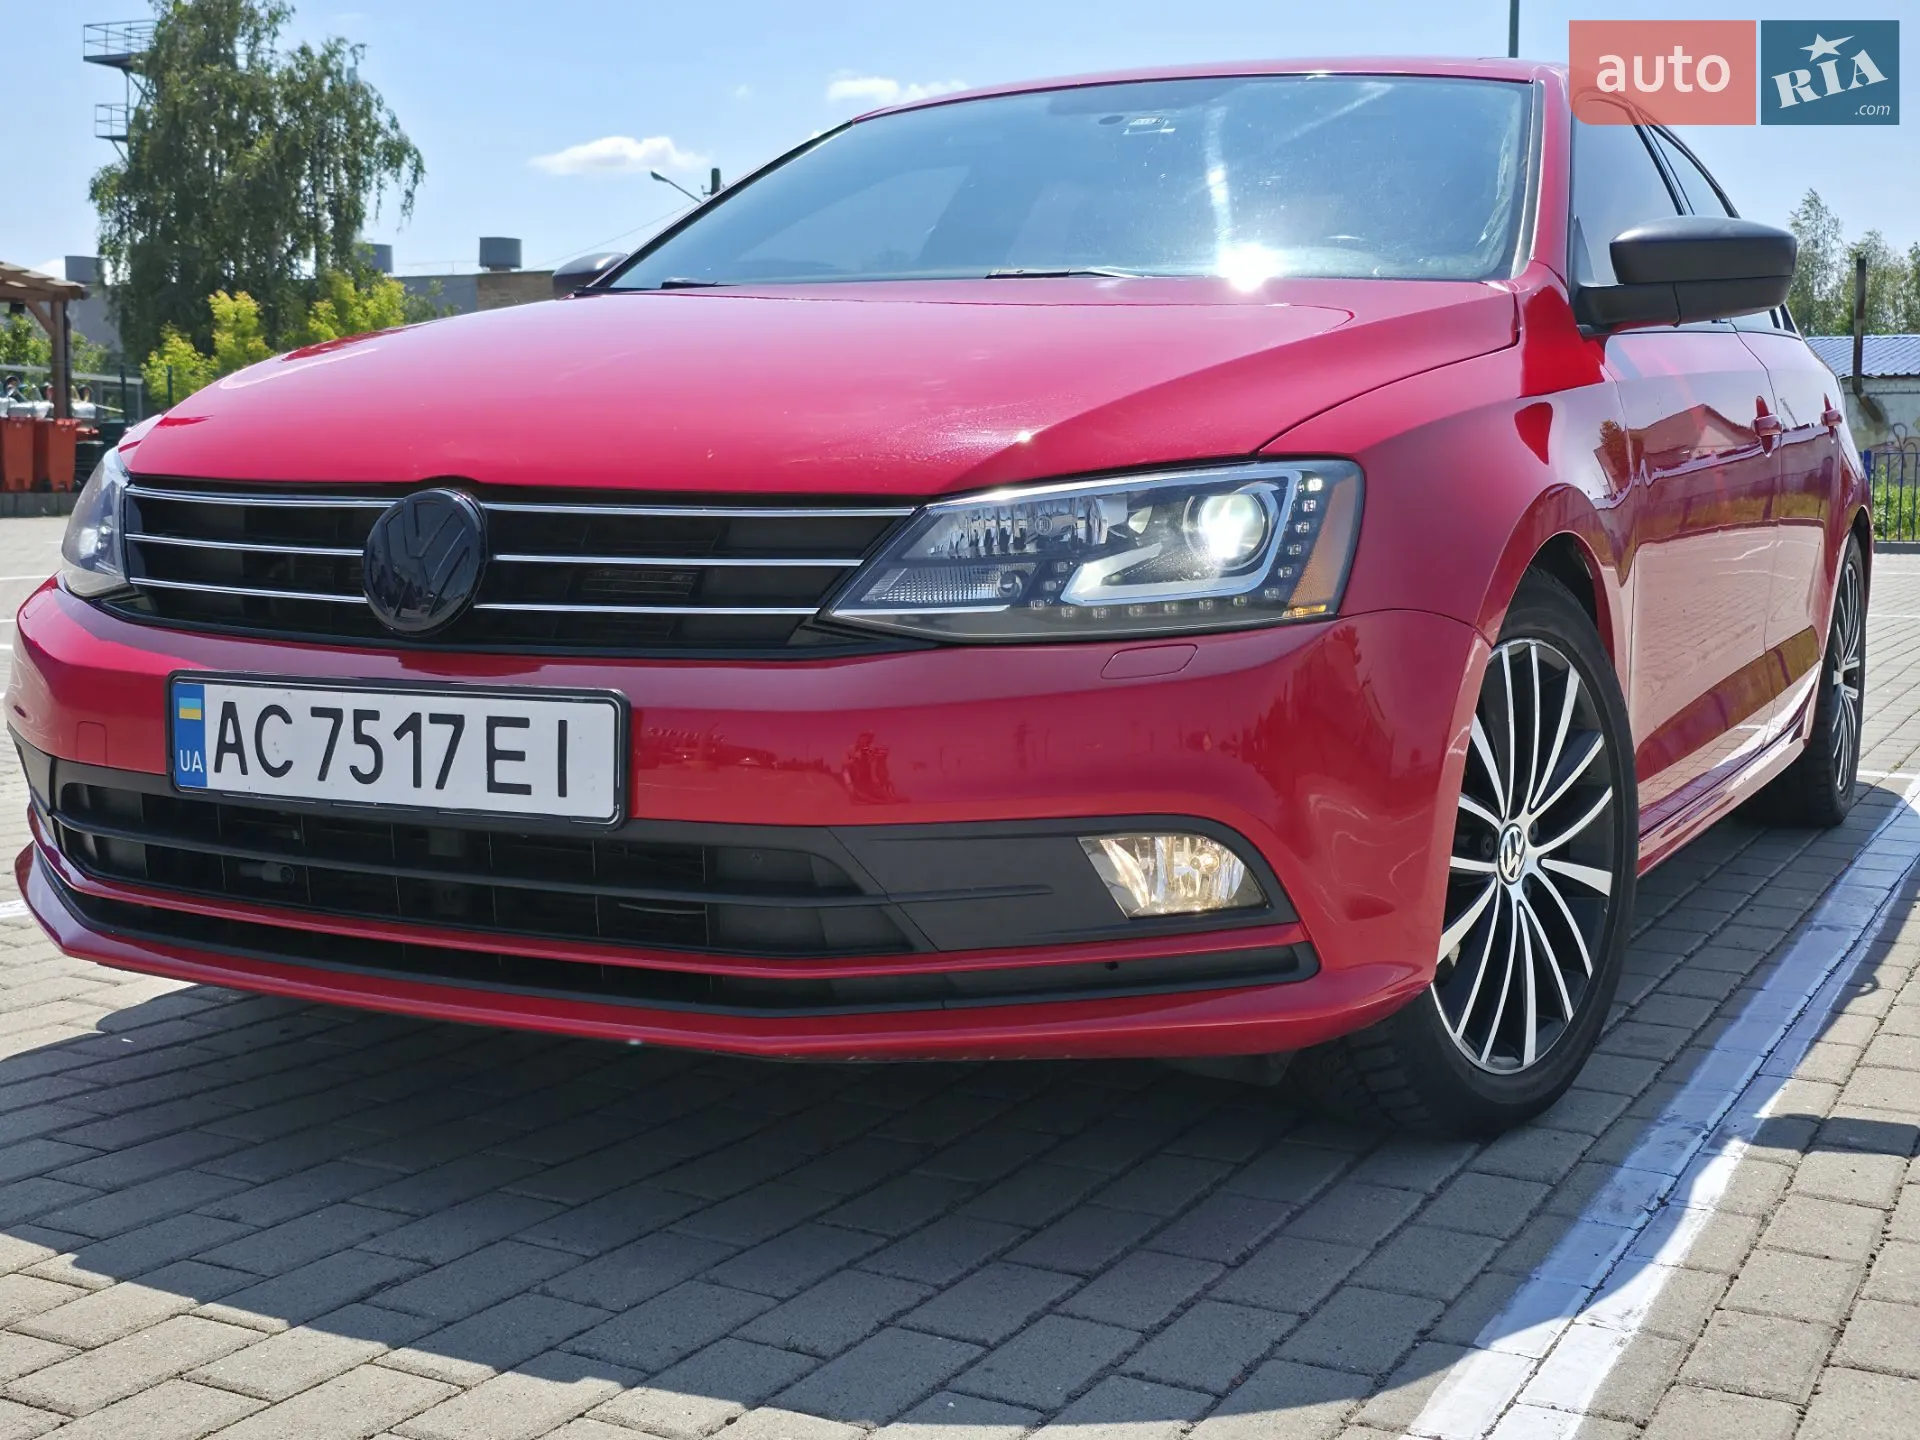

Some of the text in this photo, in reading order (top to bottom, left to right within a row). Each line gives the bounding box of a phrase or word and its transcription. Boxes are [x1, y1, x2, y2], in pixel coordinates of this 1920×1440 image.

[179, 749, 204, 774] UA
[213, 701, 568, 798] AC 7517 EI
